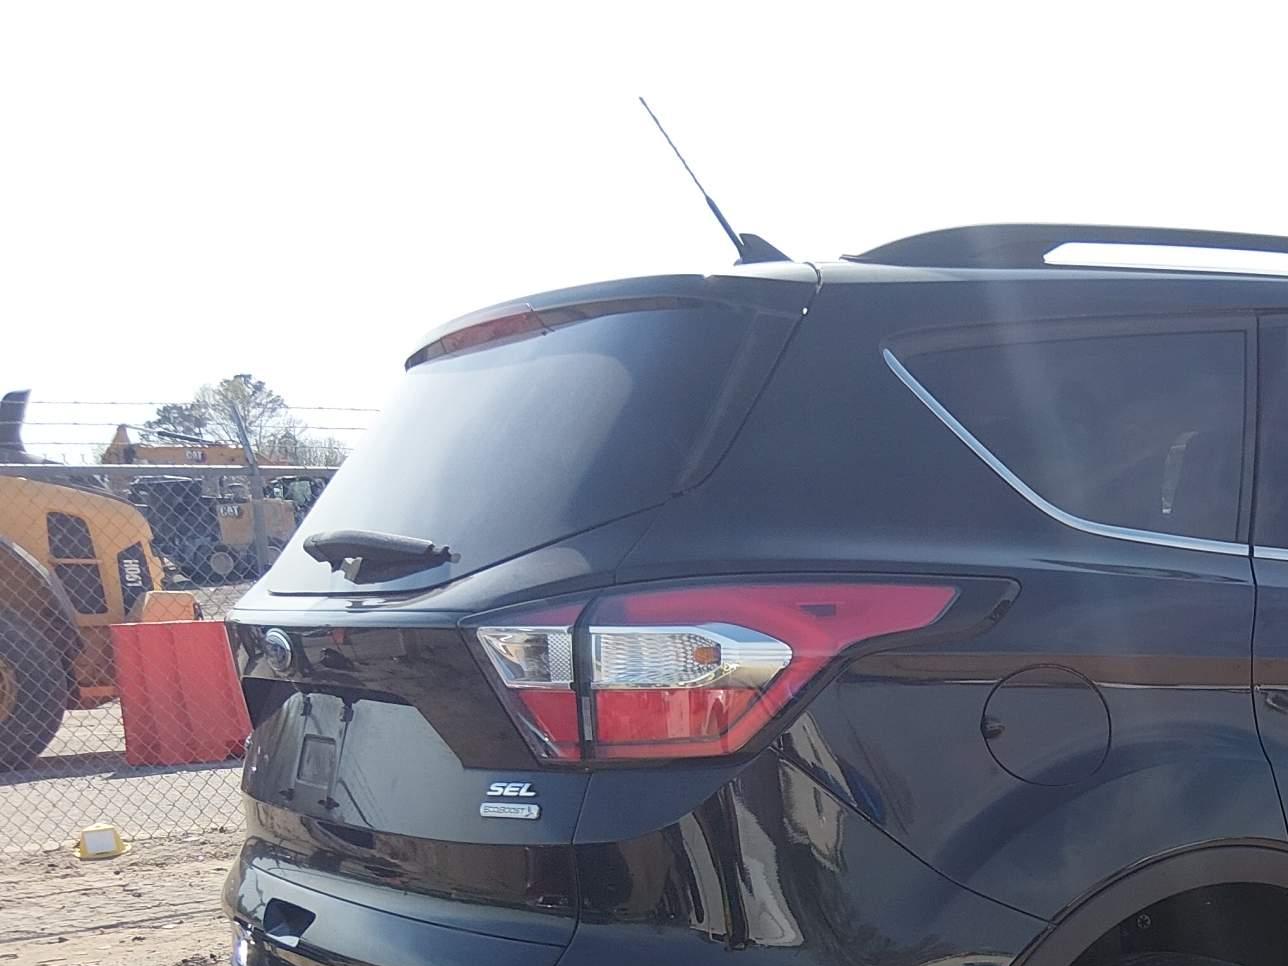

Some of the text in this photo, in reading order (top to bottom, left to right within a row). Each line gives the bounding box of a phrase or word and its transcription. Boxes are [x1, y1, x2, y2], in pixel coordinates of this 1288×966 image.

[186, 450, 203, 461] CAT
[220, 505, 239, 518] CAT
[123, 559, 142, 587] L90H
[486, 782, 536, 797] SEL
